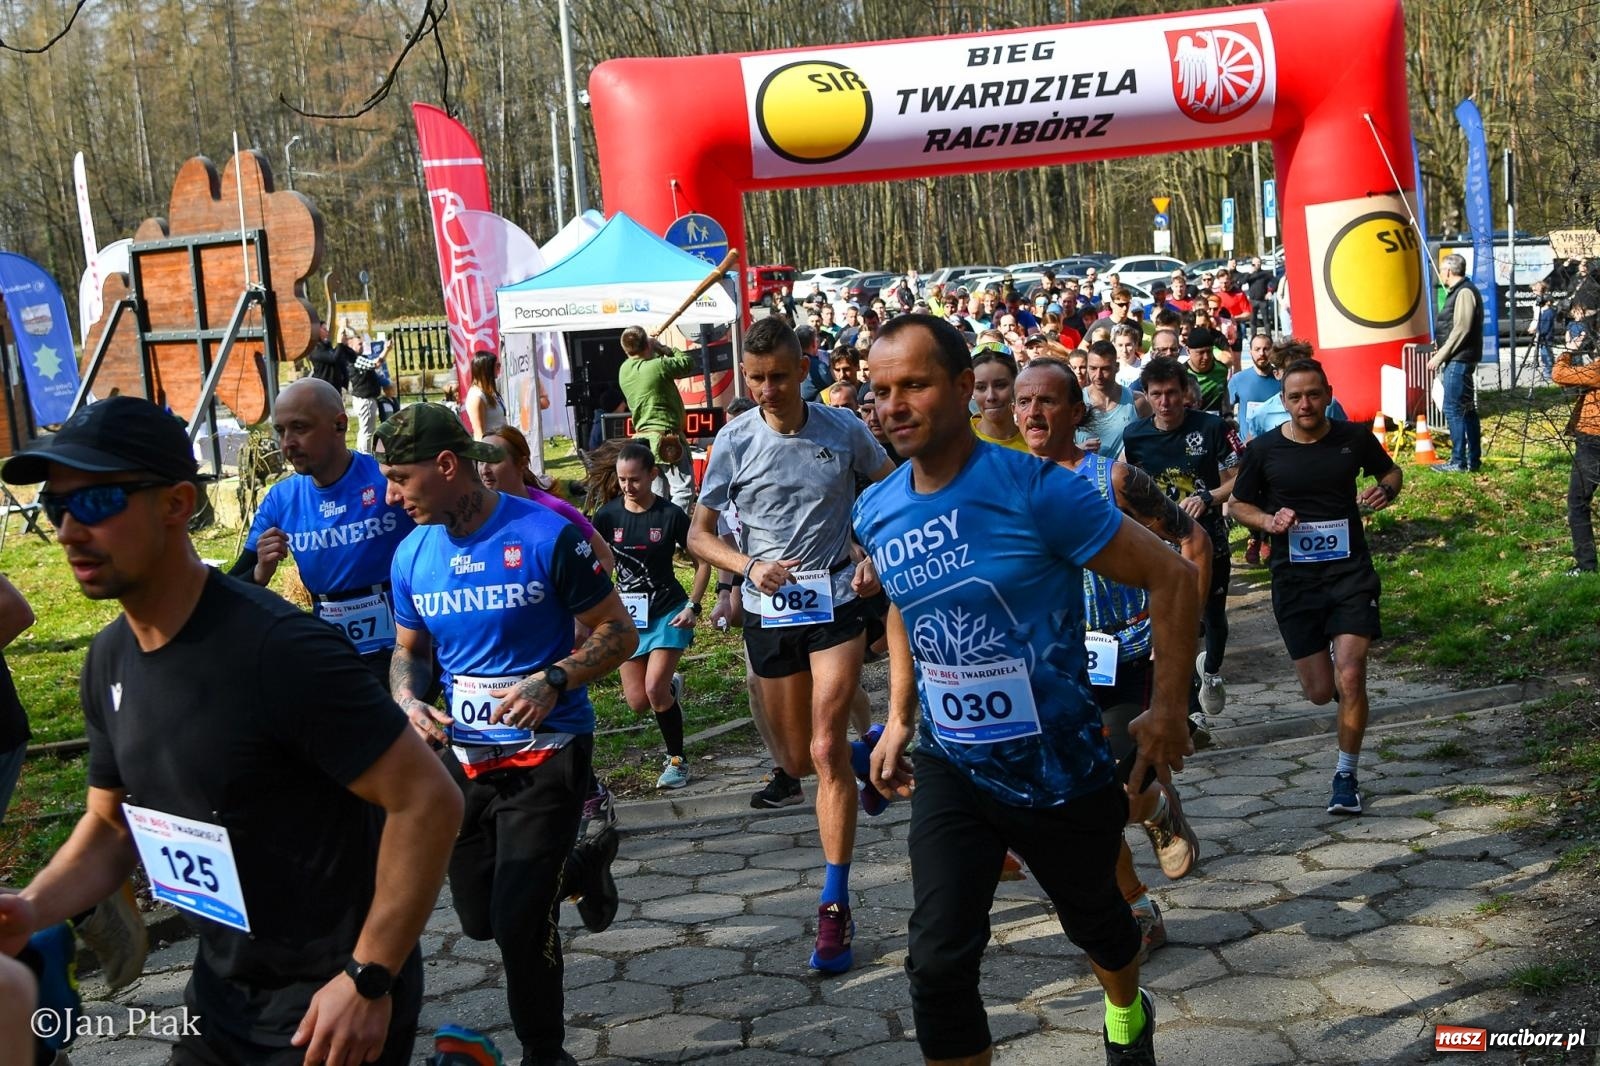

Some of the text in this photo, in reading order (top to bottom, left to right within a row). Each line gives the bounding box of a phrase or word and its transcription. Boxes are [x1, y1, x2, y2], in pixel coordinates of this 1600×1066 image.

[967, 41, 1056, 67] BIEG
[807, 71, 868, 93] SIR
[896, 69, 1137, 115] TWARDZIELA
[922, 111, 1115, 153] RACIBÓRZ
[1376, 227, 1419, 253] SIR
[514, 303, 598, 320] PersonalBest
[687, 413, 713, 433] 04
[285, 512, 397, 552] RUNNERS
[872, 508, 960, 576] MORSY
[1300, 534, 1338, 551] 029
[883, 543, 976, 600] ACIBÓRZ
[412, 581, 545, 618] RUNNERS
[772, 589, 819, 611] 082
[940, 671, 958, 679] BIEG
[960, 666, 1018, 679] TWARDZIELA
[942, 690, 1012, 722] 030
[161, 846, 219, 893] 125
